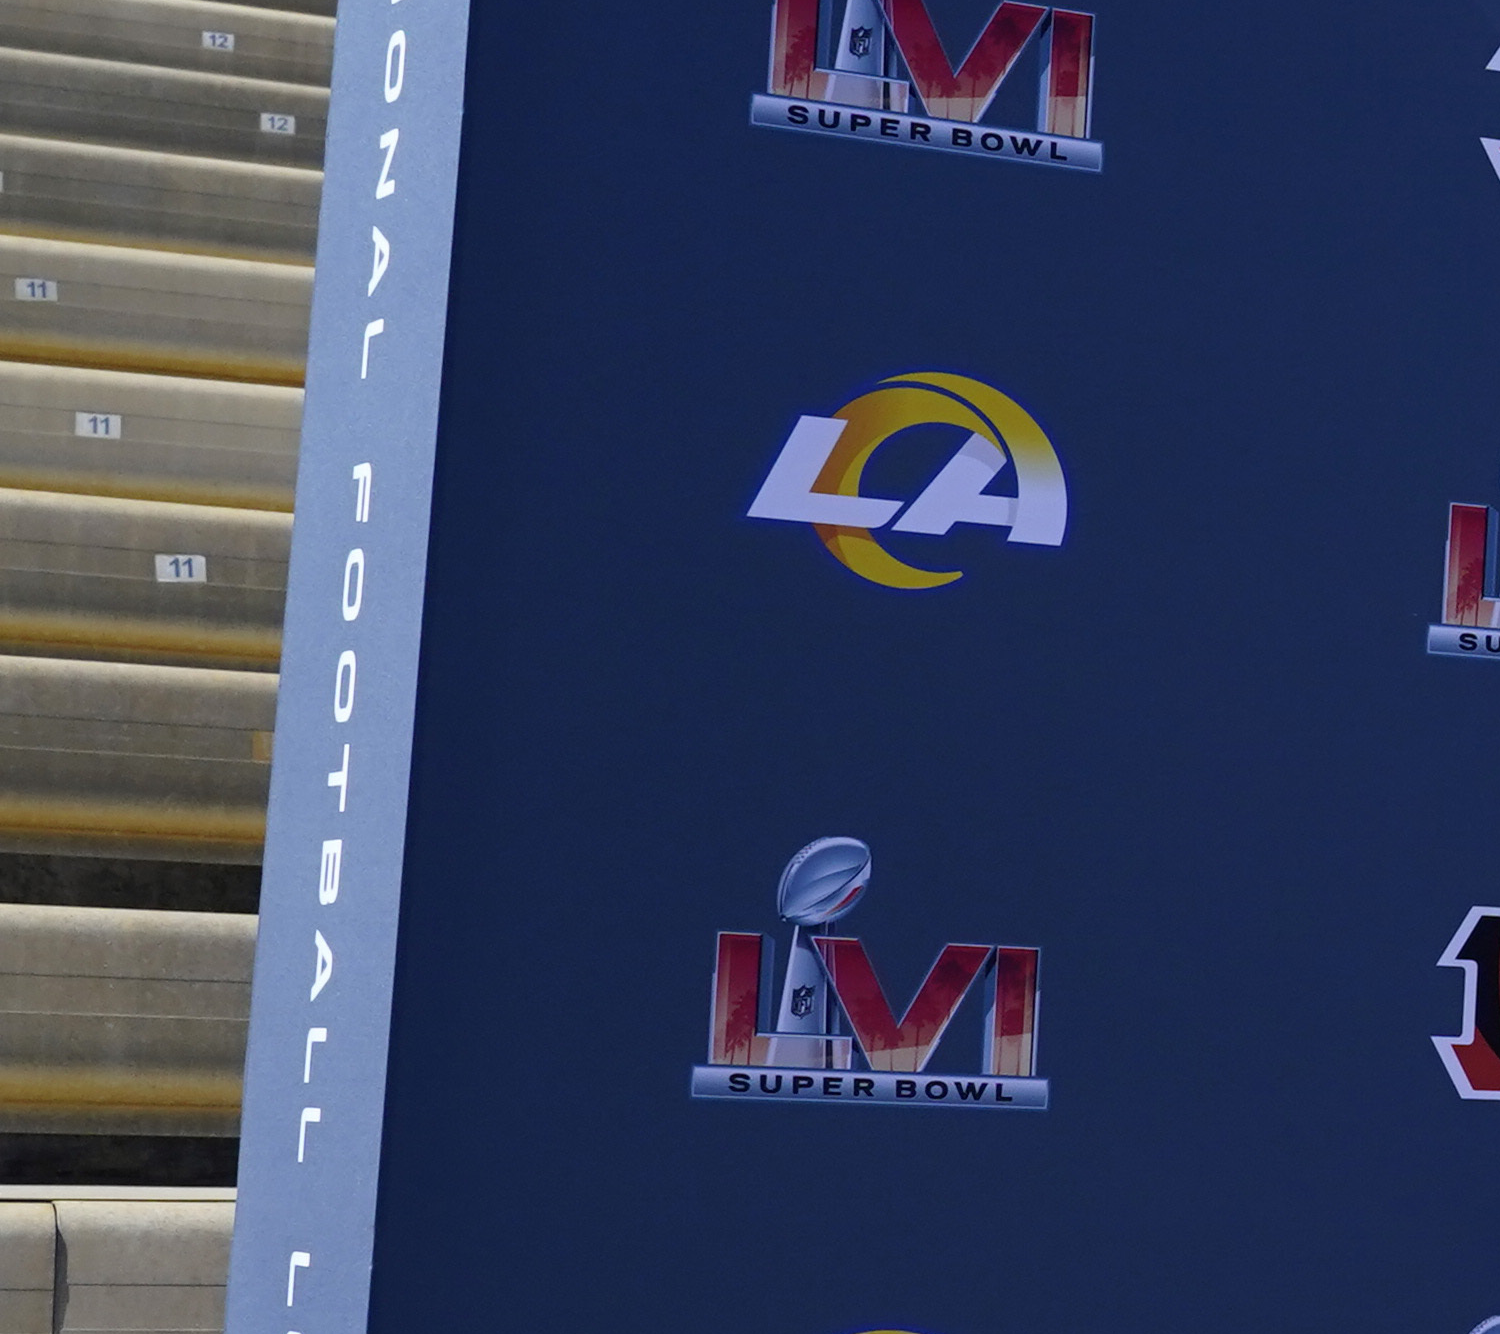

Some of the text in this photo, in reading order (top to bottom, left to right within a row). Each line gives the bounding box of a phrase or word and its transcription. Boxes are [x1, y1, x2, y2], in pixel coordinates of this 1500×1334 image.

[210, 34, 228, 49] 12
[268, 116, 288, 131] 12
[786, 103, 1069, 161] SUPER BOWL
[28, 281, 46, 298] 11
[89, 416, 109, 435] 11
[746, 373, 1066, 547] LA
[170, 558, 193, 578] 11
[296, 462, 372, 1163] FOOTBALL
[709, 931, 1040, 1076] LVI
[727, 1072, 1015, 1101] SUPER BOWL
